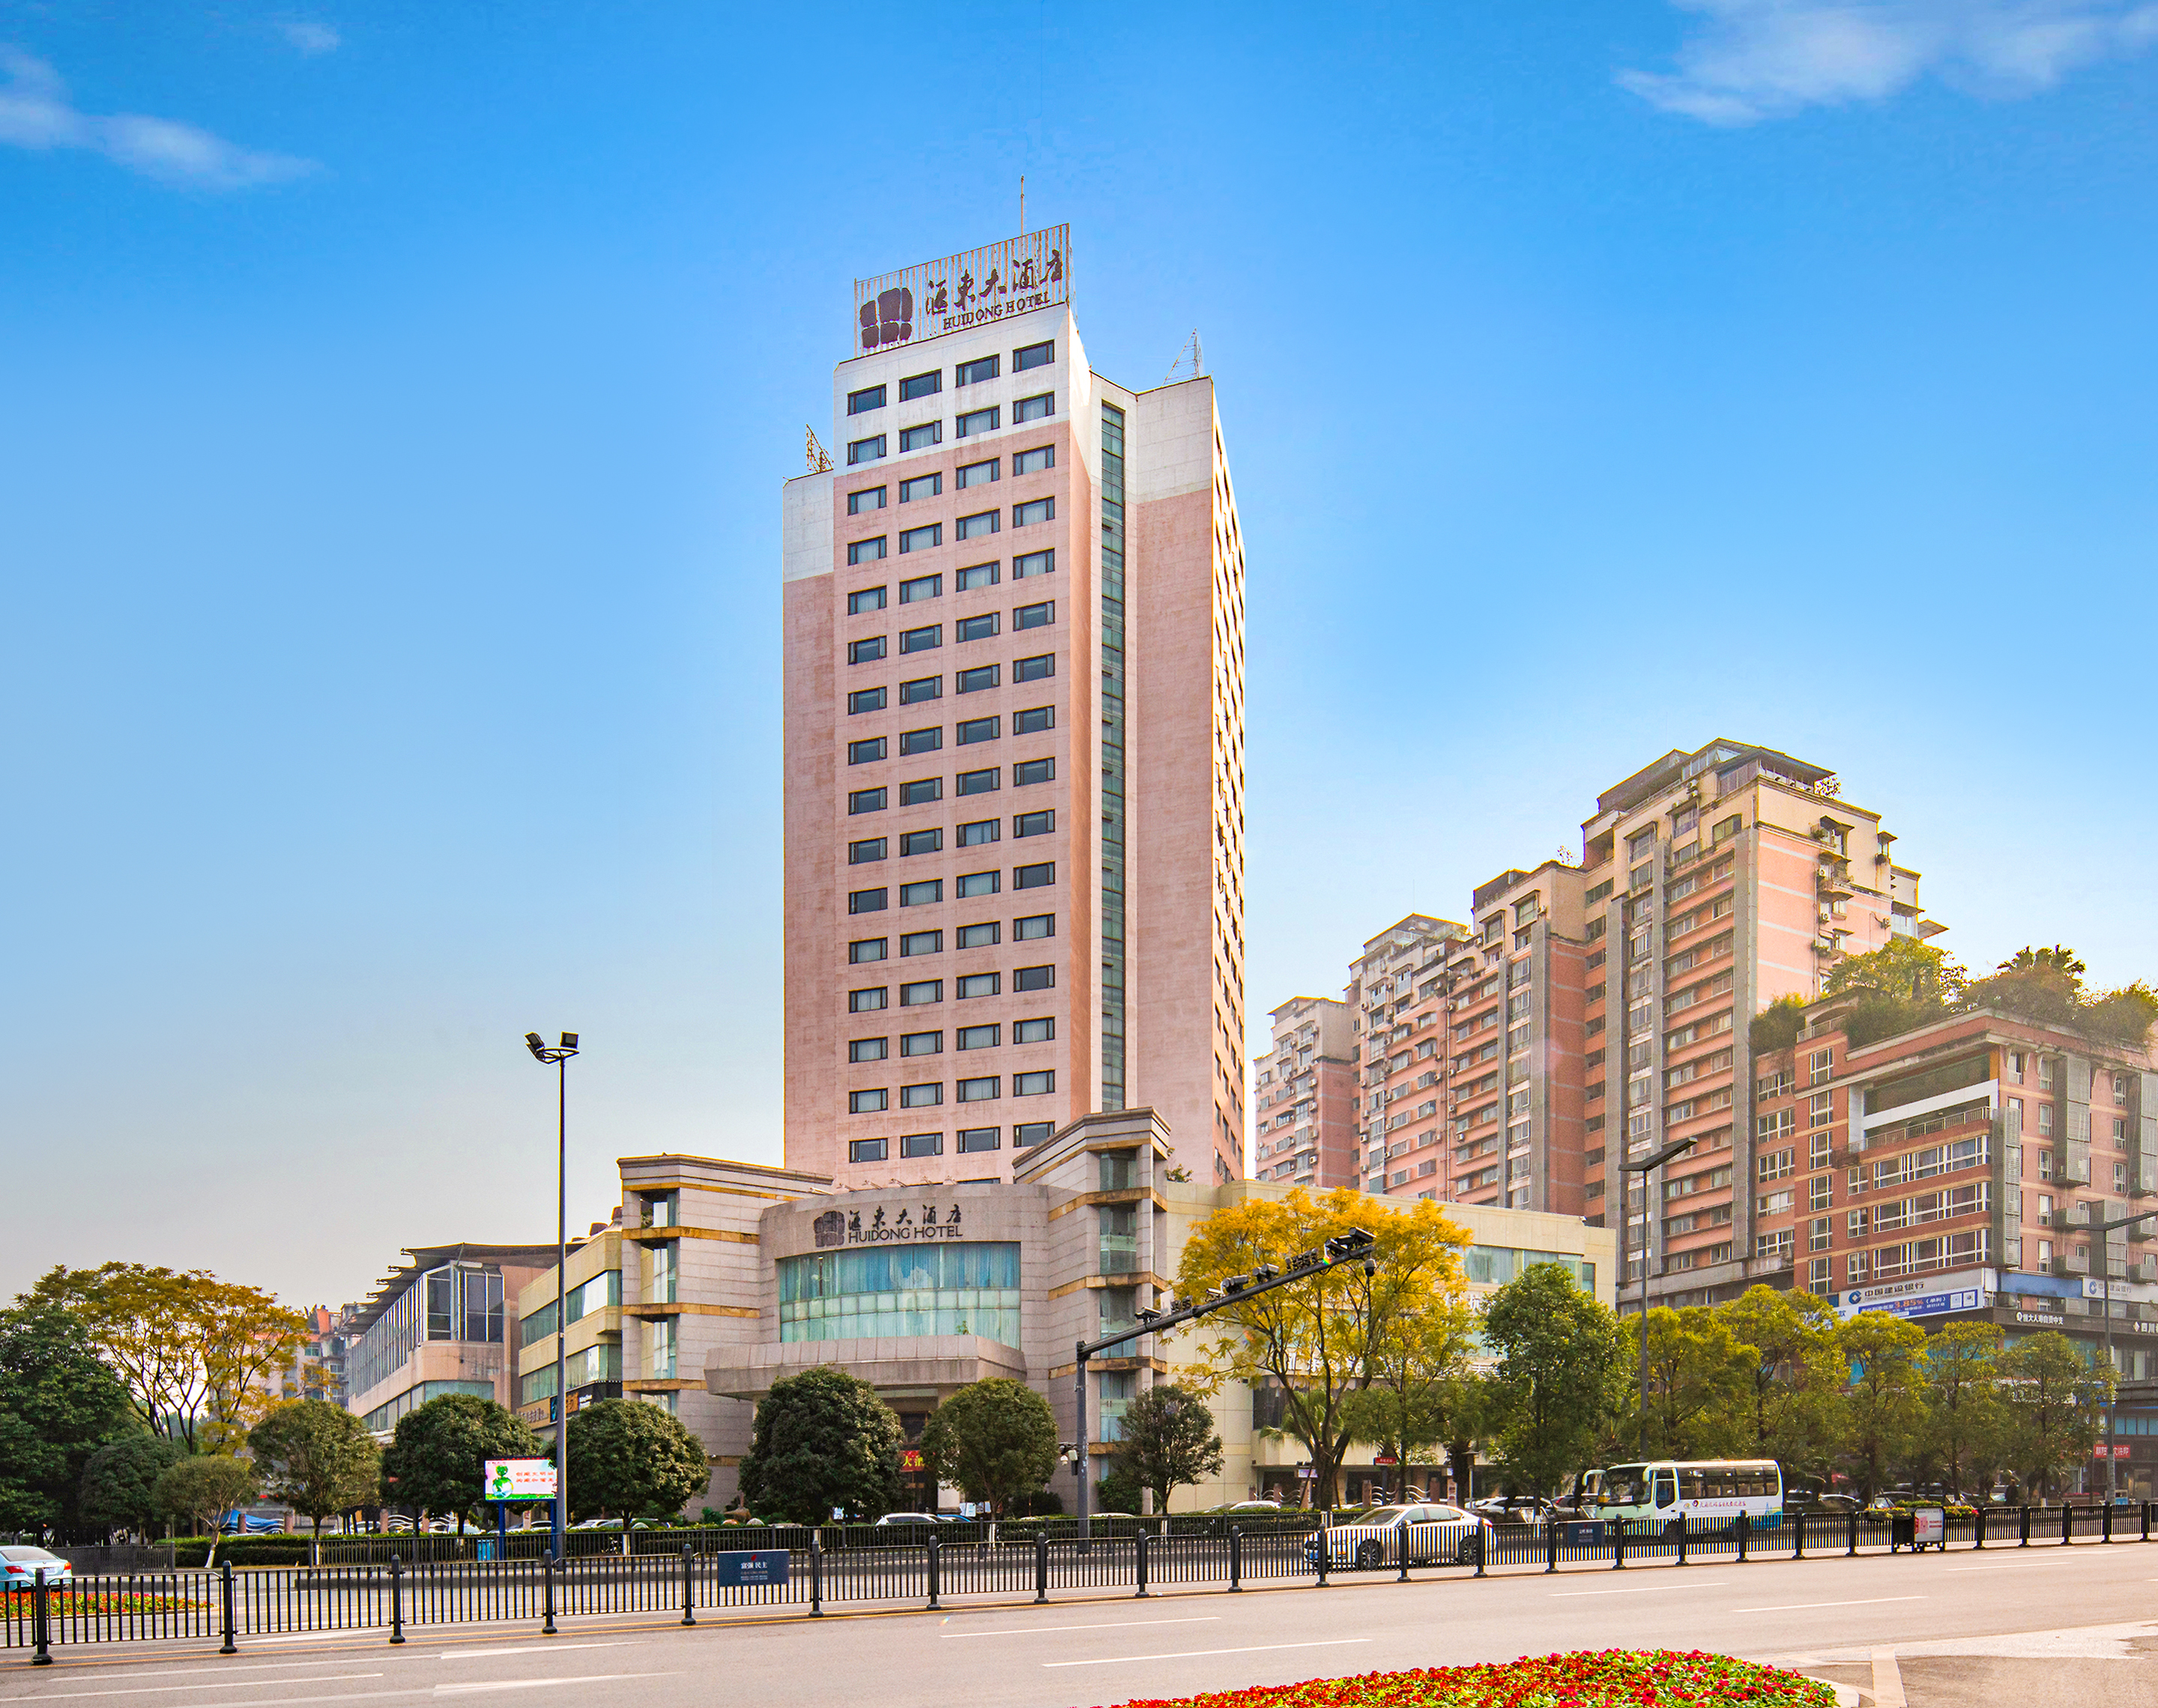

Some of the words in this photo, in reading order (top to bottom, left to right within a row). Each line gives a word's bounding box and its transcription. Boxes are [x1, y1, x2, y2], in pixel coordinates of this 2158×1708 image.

[943, 305, 1003, 330] HUIDONG
[1006, 292, 1050, 312] HOTEL
[848, 1227, 910, 1244] HUIDONG
[914, 1225, 963, 1238] HOTEL
[1864, 1281, 1924, 1297] 中国建设银行
[1894, 1298, 1924, 1309] 3.85%
